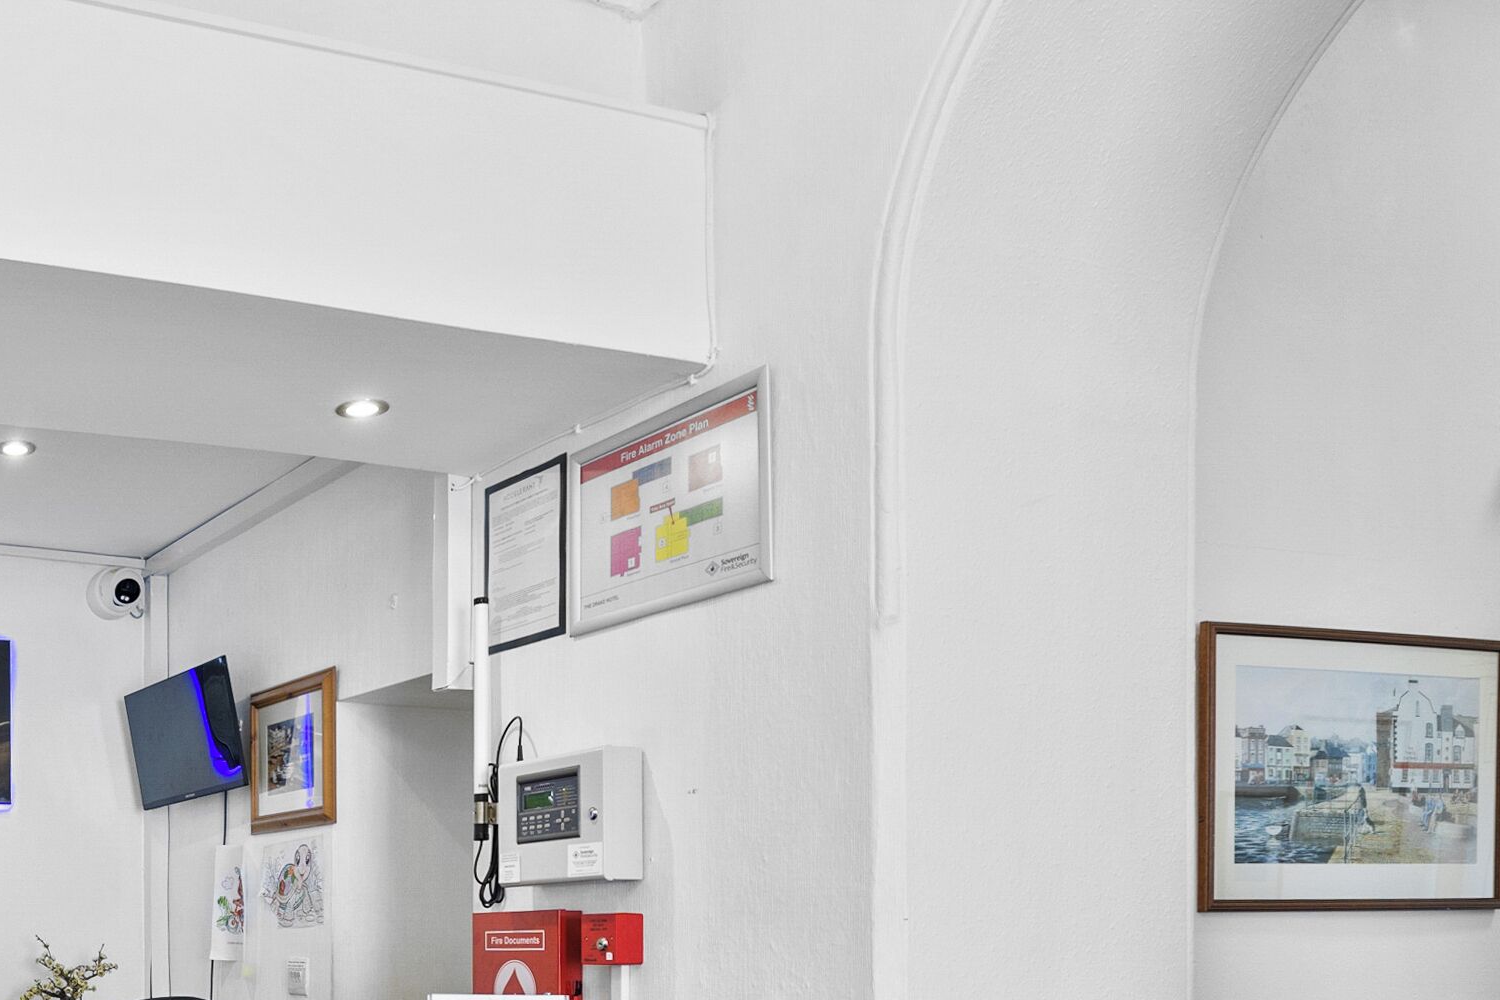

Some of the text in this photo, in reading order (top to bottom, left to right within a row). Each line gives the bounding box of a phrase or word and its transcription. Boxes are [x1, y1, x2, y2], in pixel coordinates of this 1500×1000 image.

[620, 418, 708, 462] Fire Alarm Zone Plan
[491, 936, 540, 945] Fire Documents
